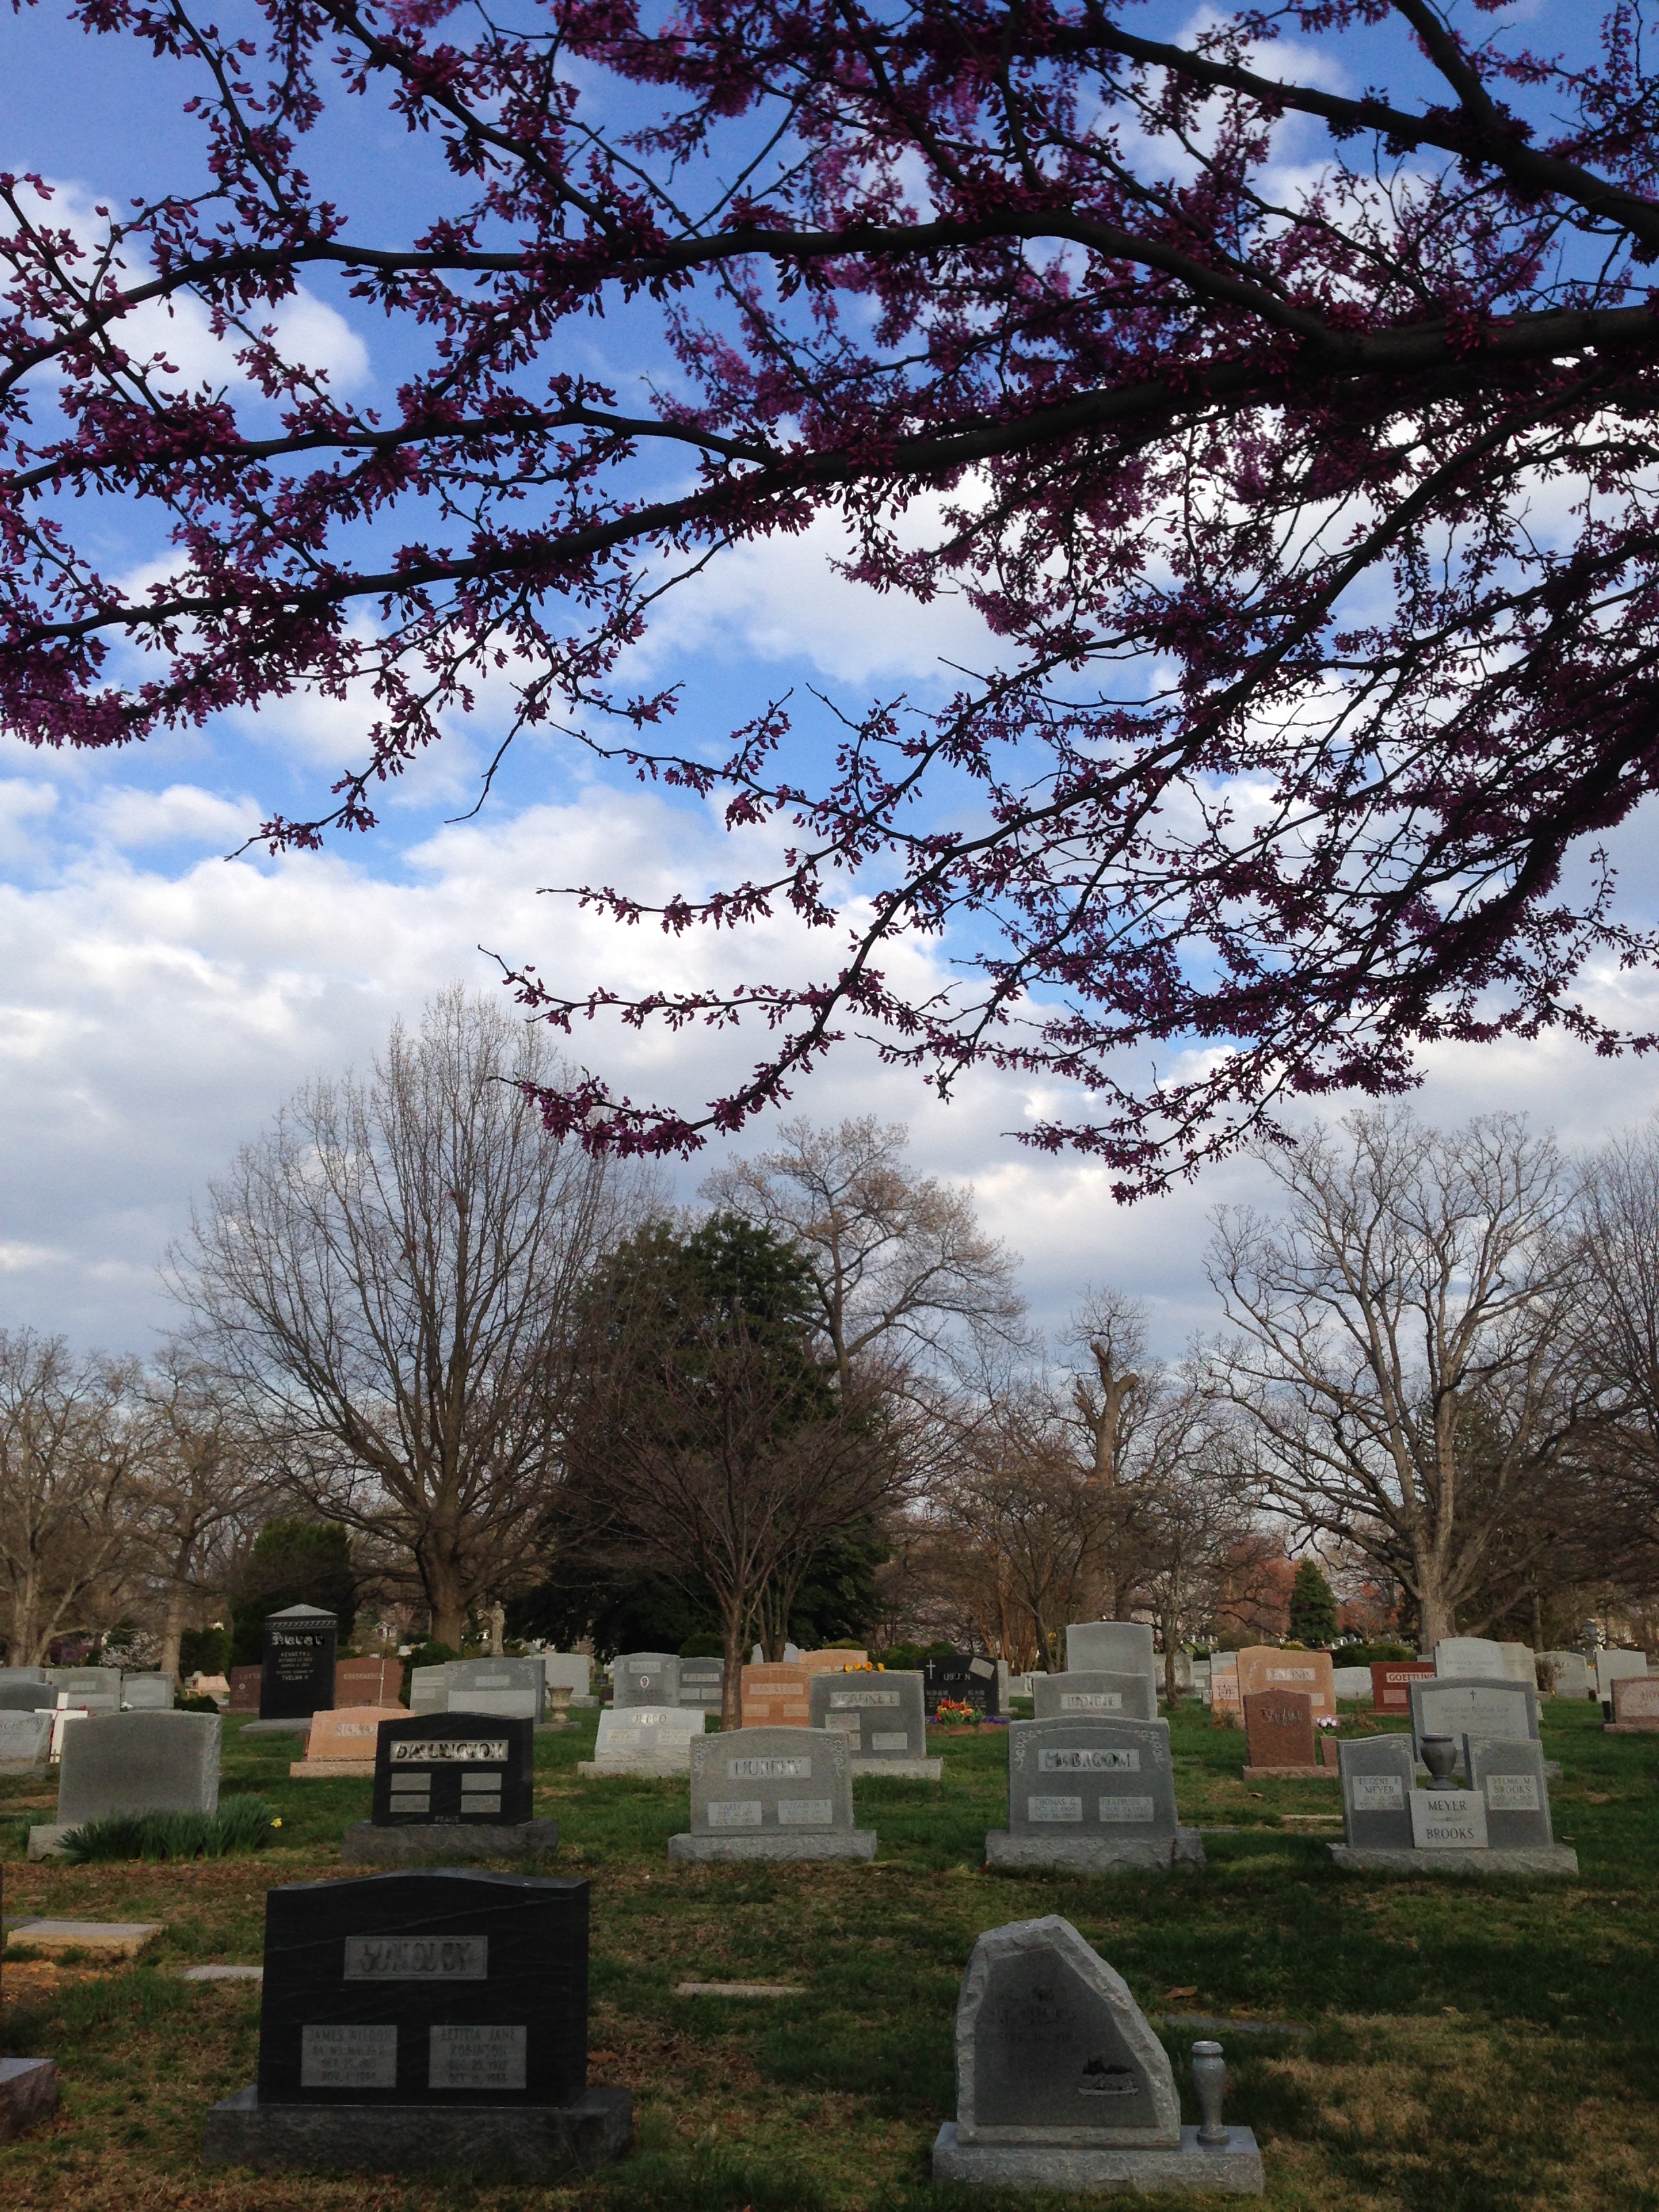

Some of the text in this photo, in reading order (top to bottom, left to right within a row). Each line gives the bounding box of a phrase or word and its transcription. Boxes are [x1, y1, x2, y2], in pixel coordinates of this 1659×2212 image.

[1365, 1785, 1394, 1794] MEYER
[1494, 1785, 1532, 1794] BROOKS
[1428, 1800, 1467, 1811] MEYER
[1427, 1828, 1474, 1839] BROOKS
[309, 2028, 343, 2042] JAMES
[441, 2028, 516, 2041] LETITIA JANE
[451, 2043, 508, 2057] ROBINSON
